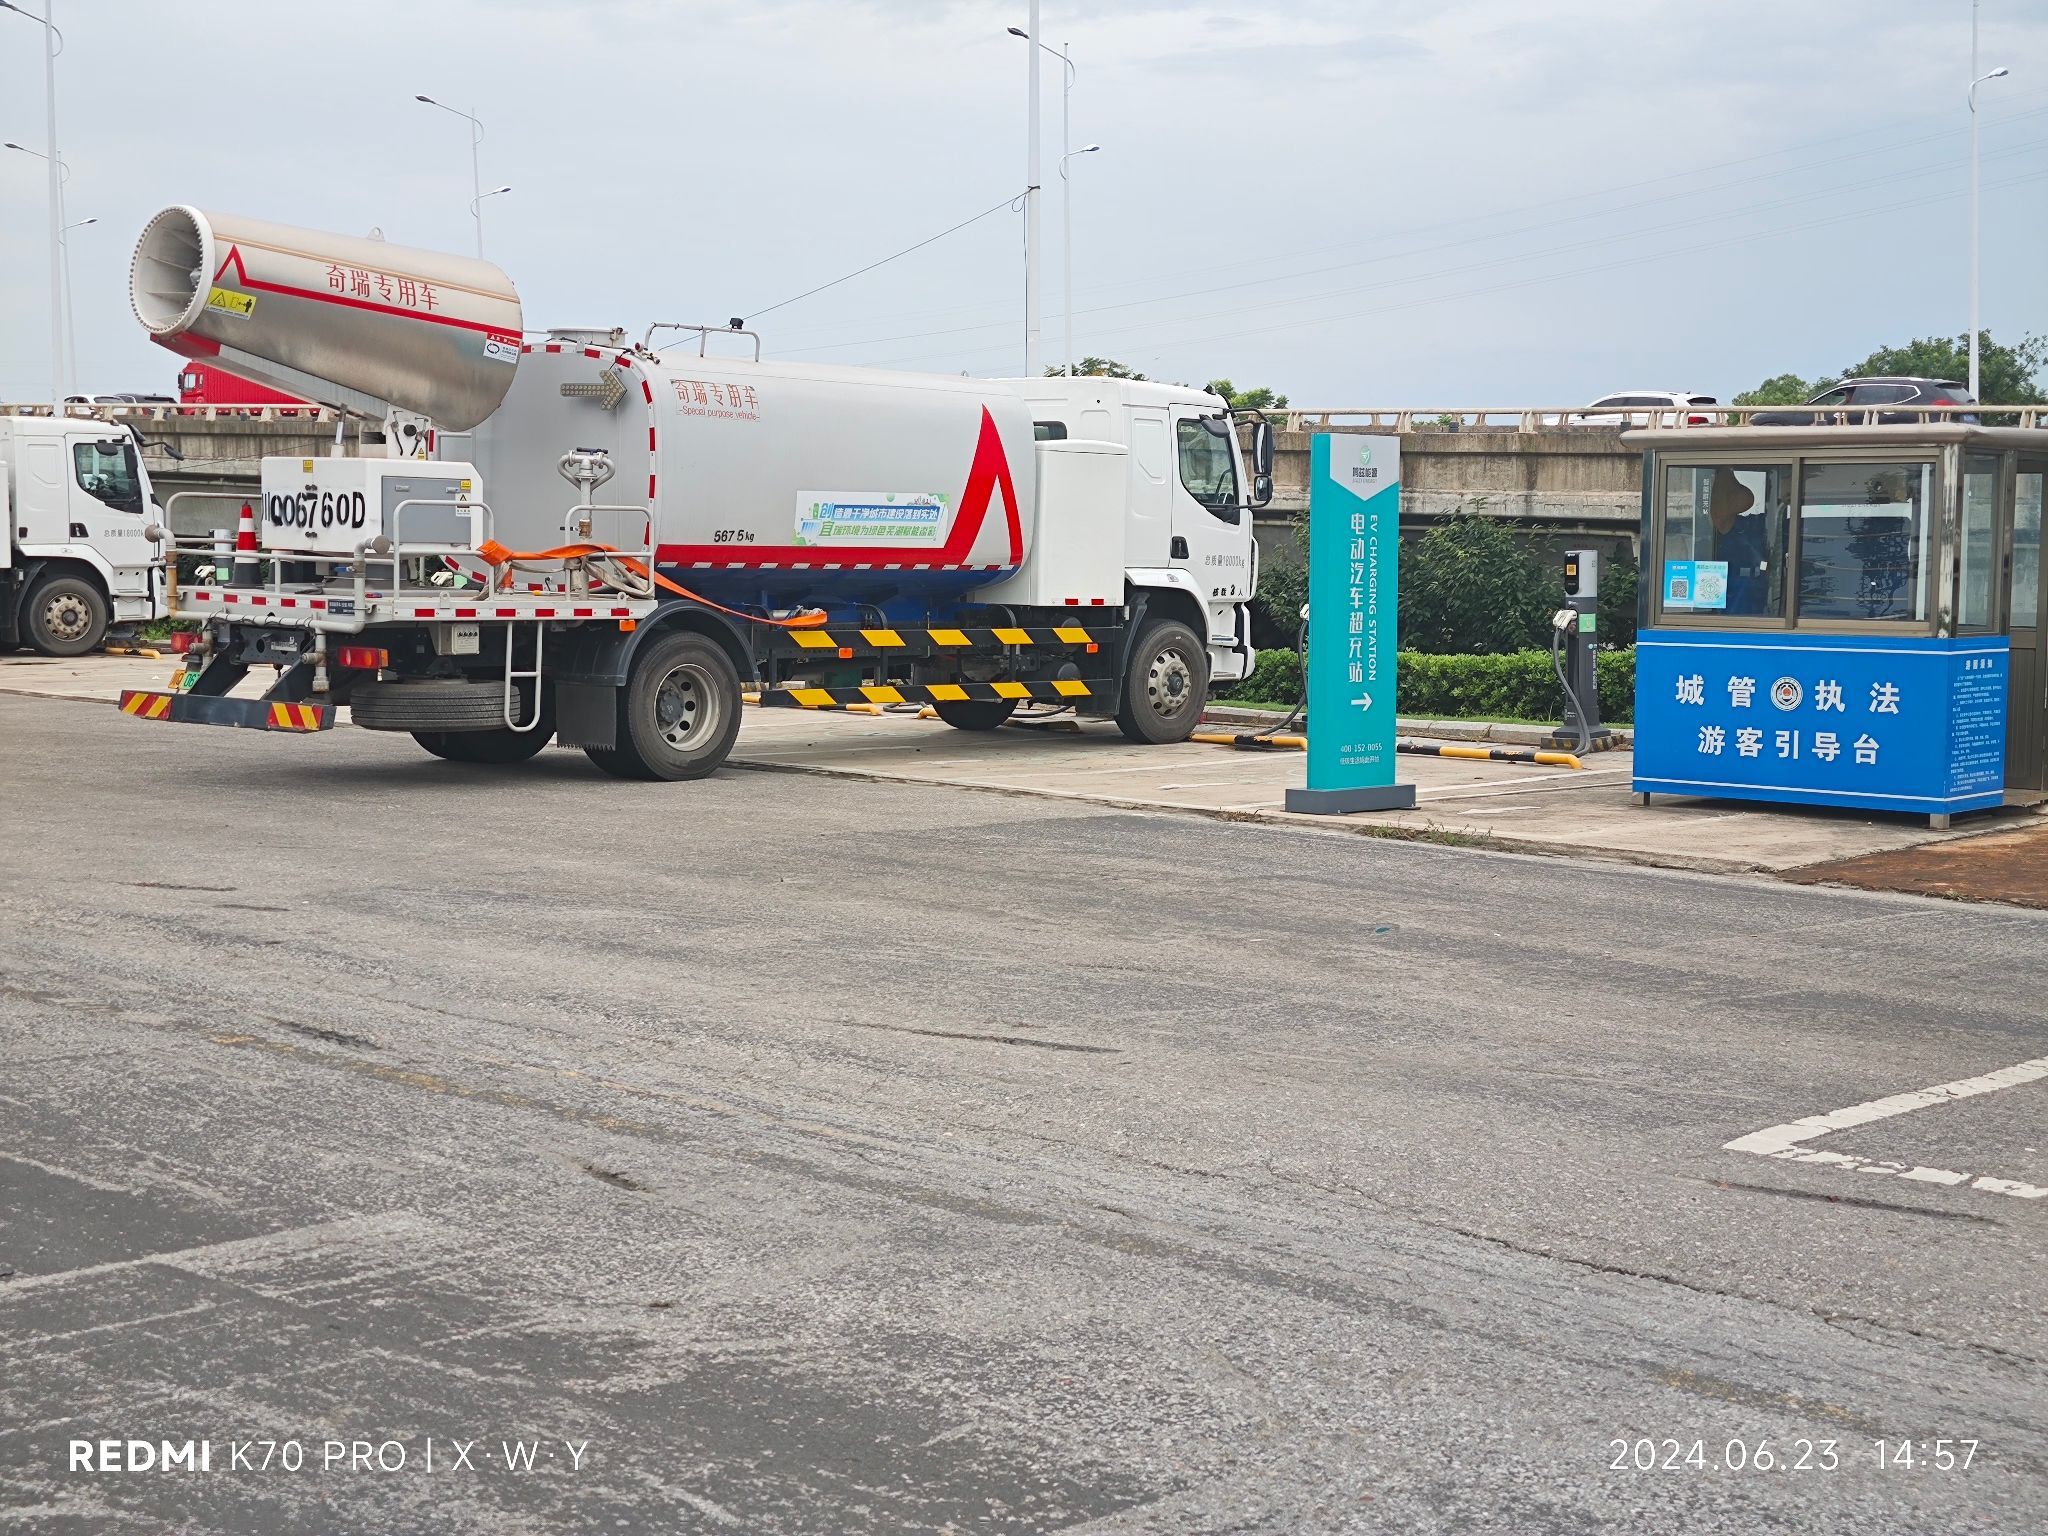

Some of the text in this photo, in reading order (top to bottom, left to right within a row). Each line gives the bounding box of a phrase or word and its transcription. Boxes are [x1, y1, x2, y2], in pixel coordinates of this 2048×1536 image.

[326, 264, 440, 312] 奇瑞专用车
[675, 380, 758, 409] 奇瑞专用车
[103, 529, 144, 538] 总质量18000k
[1349, 512, 1366, 683] 电动汽车超充站
[1368, 514, 1378, 681] EV CHARGING STATION
[1675, 674, 1756, 708] 城管
[1815, 679, 1900, 715] 执法
[1697, 725, 1880, 765] 游客引导台
